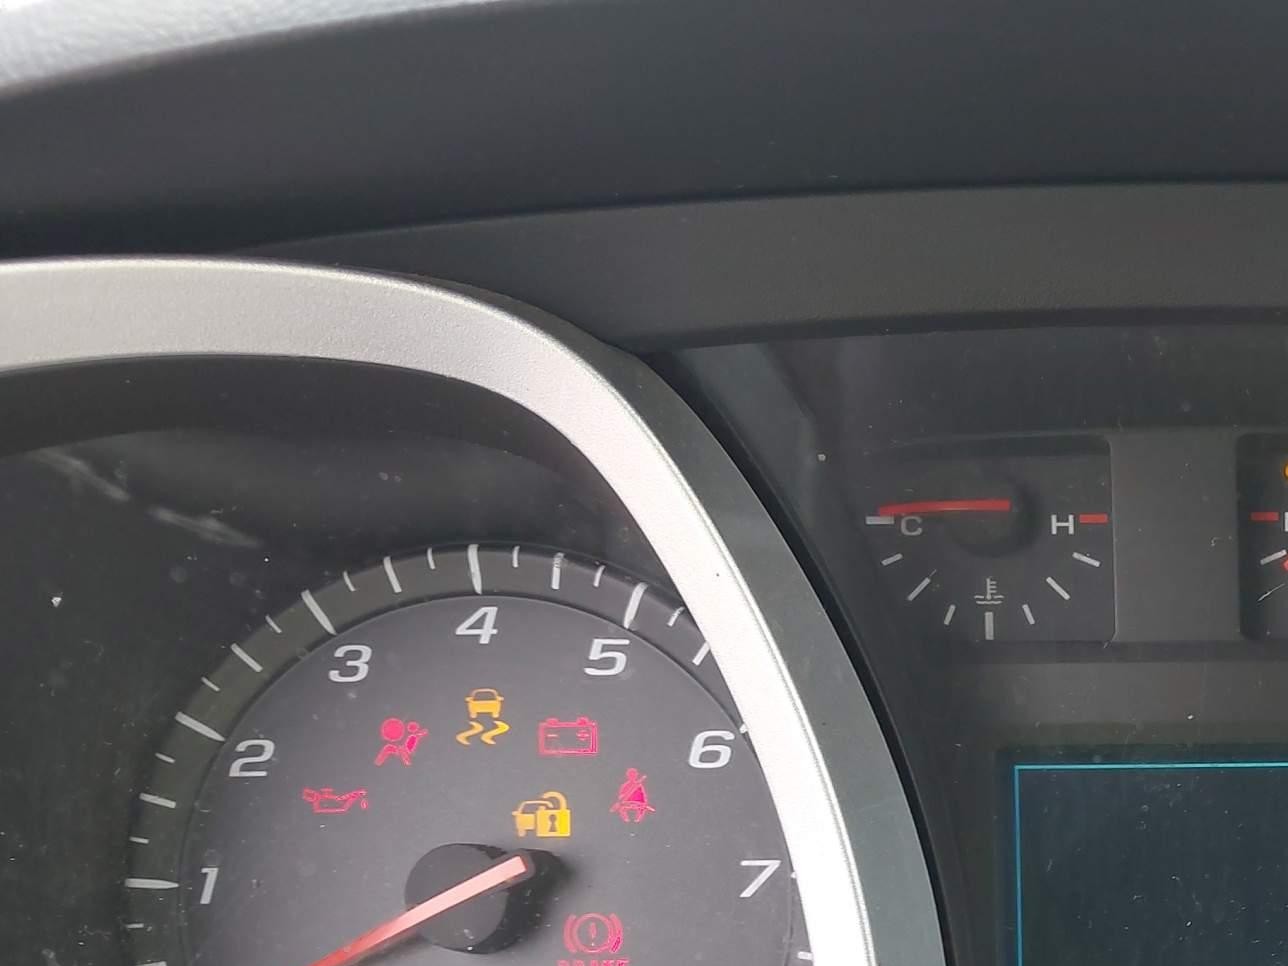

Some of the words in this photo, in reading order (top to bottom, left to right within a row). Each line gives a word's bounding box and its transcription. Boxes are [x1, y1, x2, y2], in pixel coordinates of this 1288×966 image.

[900, 515, 923, 537] C
[1051, 515, 1074, 535] H
[456, 607, 498, 644] 4
[328, 645, 372, 682] 3
[584, 639, 630, 676] 5
[228, 739, 276, 777] 2
[688, 730, 735, 768] 6
[200, 867, 219, 904] 1
[739, 860, 780, 898] 7
